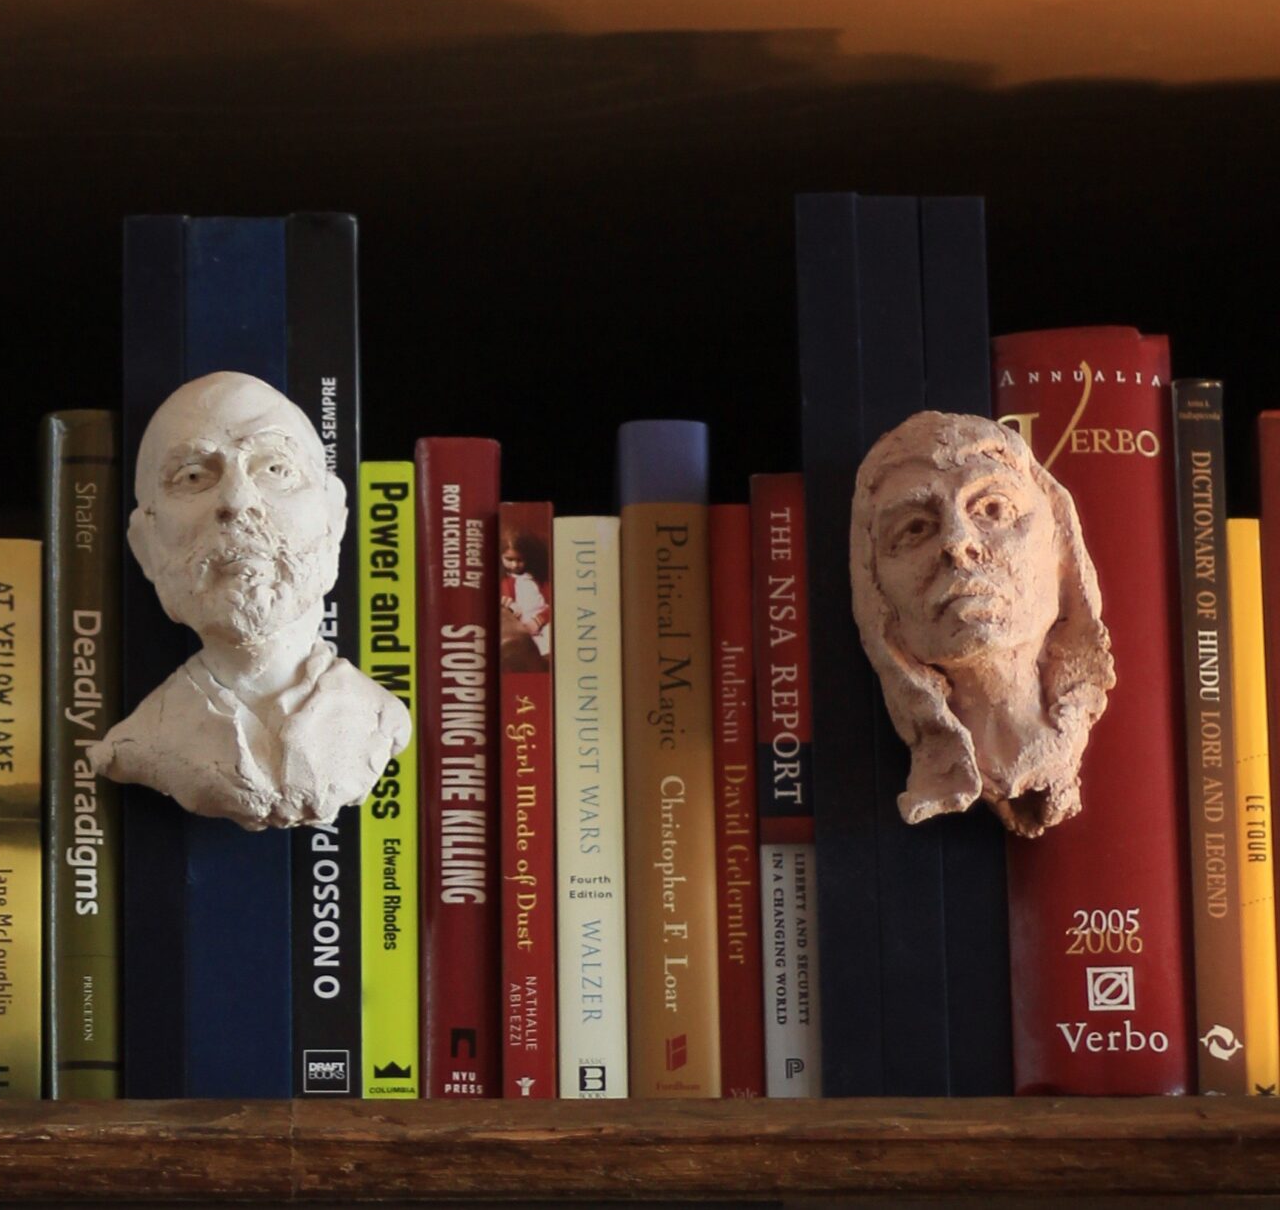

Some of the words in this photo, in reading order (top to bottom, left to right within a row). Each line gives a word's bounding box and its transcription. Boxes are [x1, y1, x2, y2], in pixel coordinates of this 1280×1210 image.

[998, 369, 1162, 388] ANNUALIA
[74, 481, 98, 553] Shafer
[442, 483, 462, 512] ROY
[370, 482, 410, 580] Power
[441, 516, 462, 588] LICKLIDER
[465, 518, 484, 565] Edited
[462, 570, 483, 590] by
[571, 539, 598, 596] JUST
[655, 522, 691, 638] Political
[370, 593, 410, 653] and
[576, 607, 598, 664] AND
[64, 609, 104, 731] Deadly
[440, 624, 487, 746] STOPPING
[516, 695, 537, 714] A
[574, 675, 600, 773] UNJUST
[646, 655, 693, 751] Magic
[440, 753, 487, 801] THE
[506, 723, 537, 777] Girl
[516, 785, 539, 850] Made
[579, 785, 601, 855] WARS
[653, 774, 688, 913] Christopher
[383, 838, 402, 891] Edward
[440, 809, 487, 904] KILLING
[504, 858, 538, 887] of
[570, 875, 612, 884] Fourth
[311, 859, 341, 968] NOSSO
[569, 890, 613, 899] Edition
[1072, 907, 1141, 935] 2005
[383, 896, 403, 951] Rhodes
[516, 893, 538, 953] Dust
[661, 921, 689, 943] F.
[1064, 927, 1144, 955] 2006
[312, 974, 340, 999] O
[581, 919, 604, 1024] WALZER
[663, 952, 690, 1012] Loar
[82, 975, 94, 1041] PRINCETON
[508, 983, 523, 1046] ABI-EZZI
[524, 976, 538, 1051] NATHALIE
[1055, 1019, 1169, 1054] Verbo
[308, 1061, 346, 1071] DRAFT
[308, 1070, 346, 1080] BOOKS
[368, 1087, 416, 1095] COLUMBIA
[443, 1084, 485, 1095] PRESS
[451, 1071, 477, 1082] NYU
